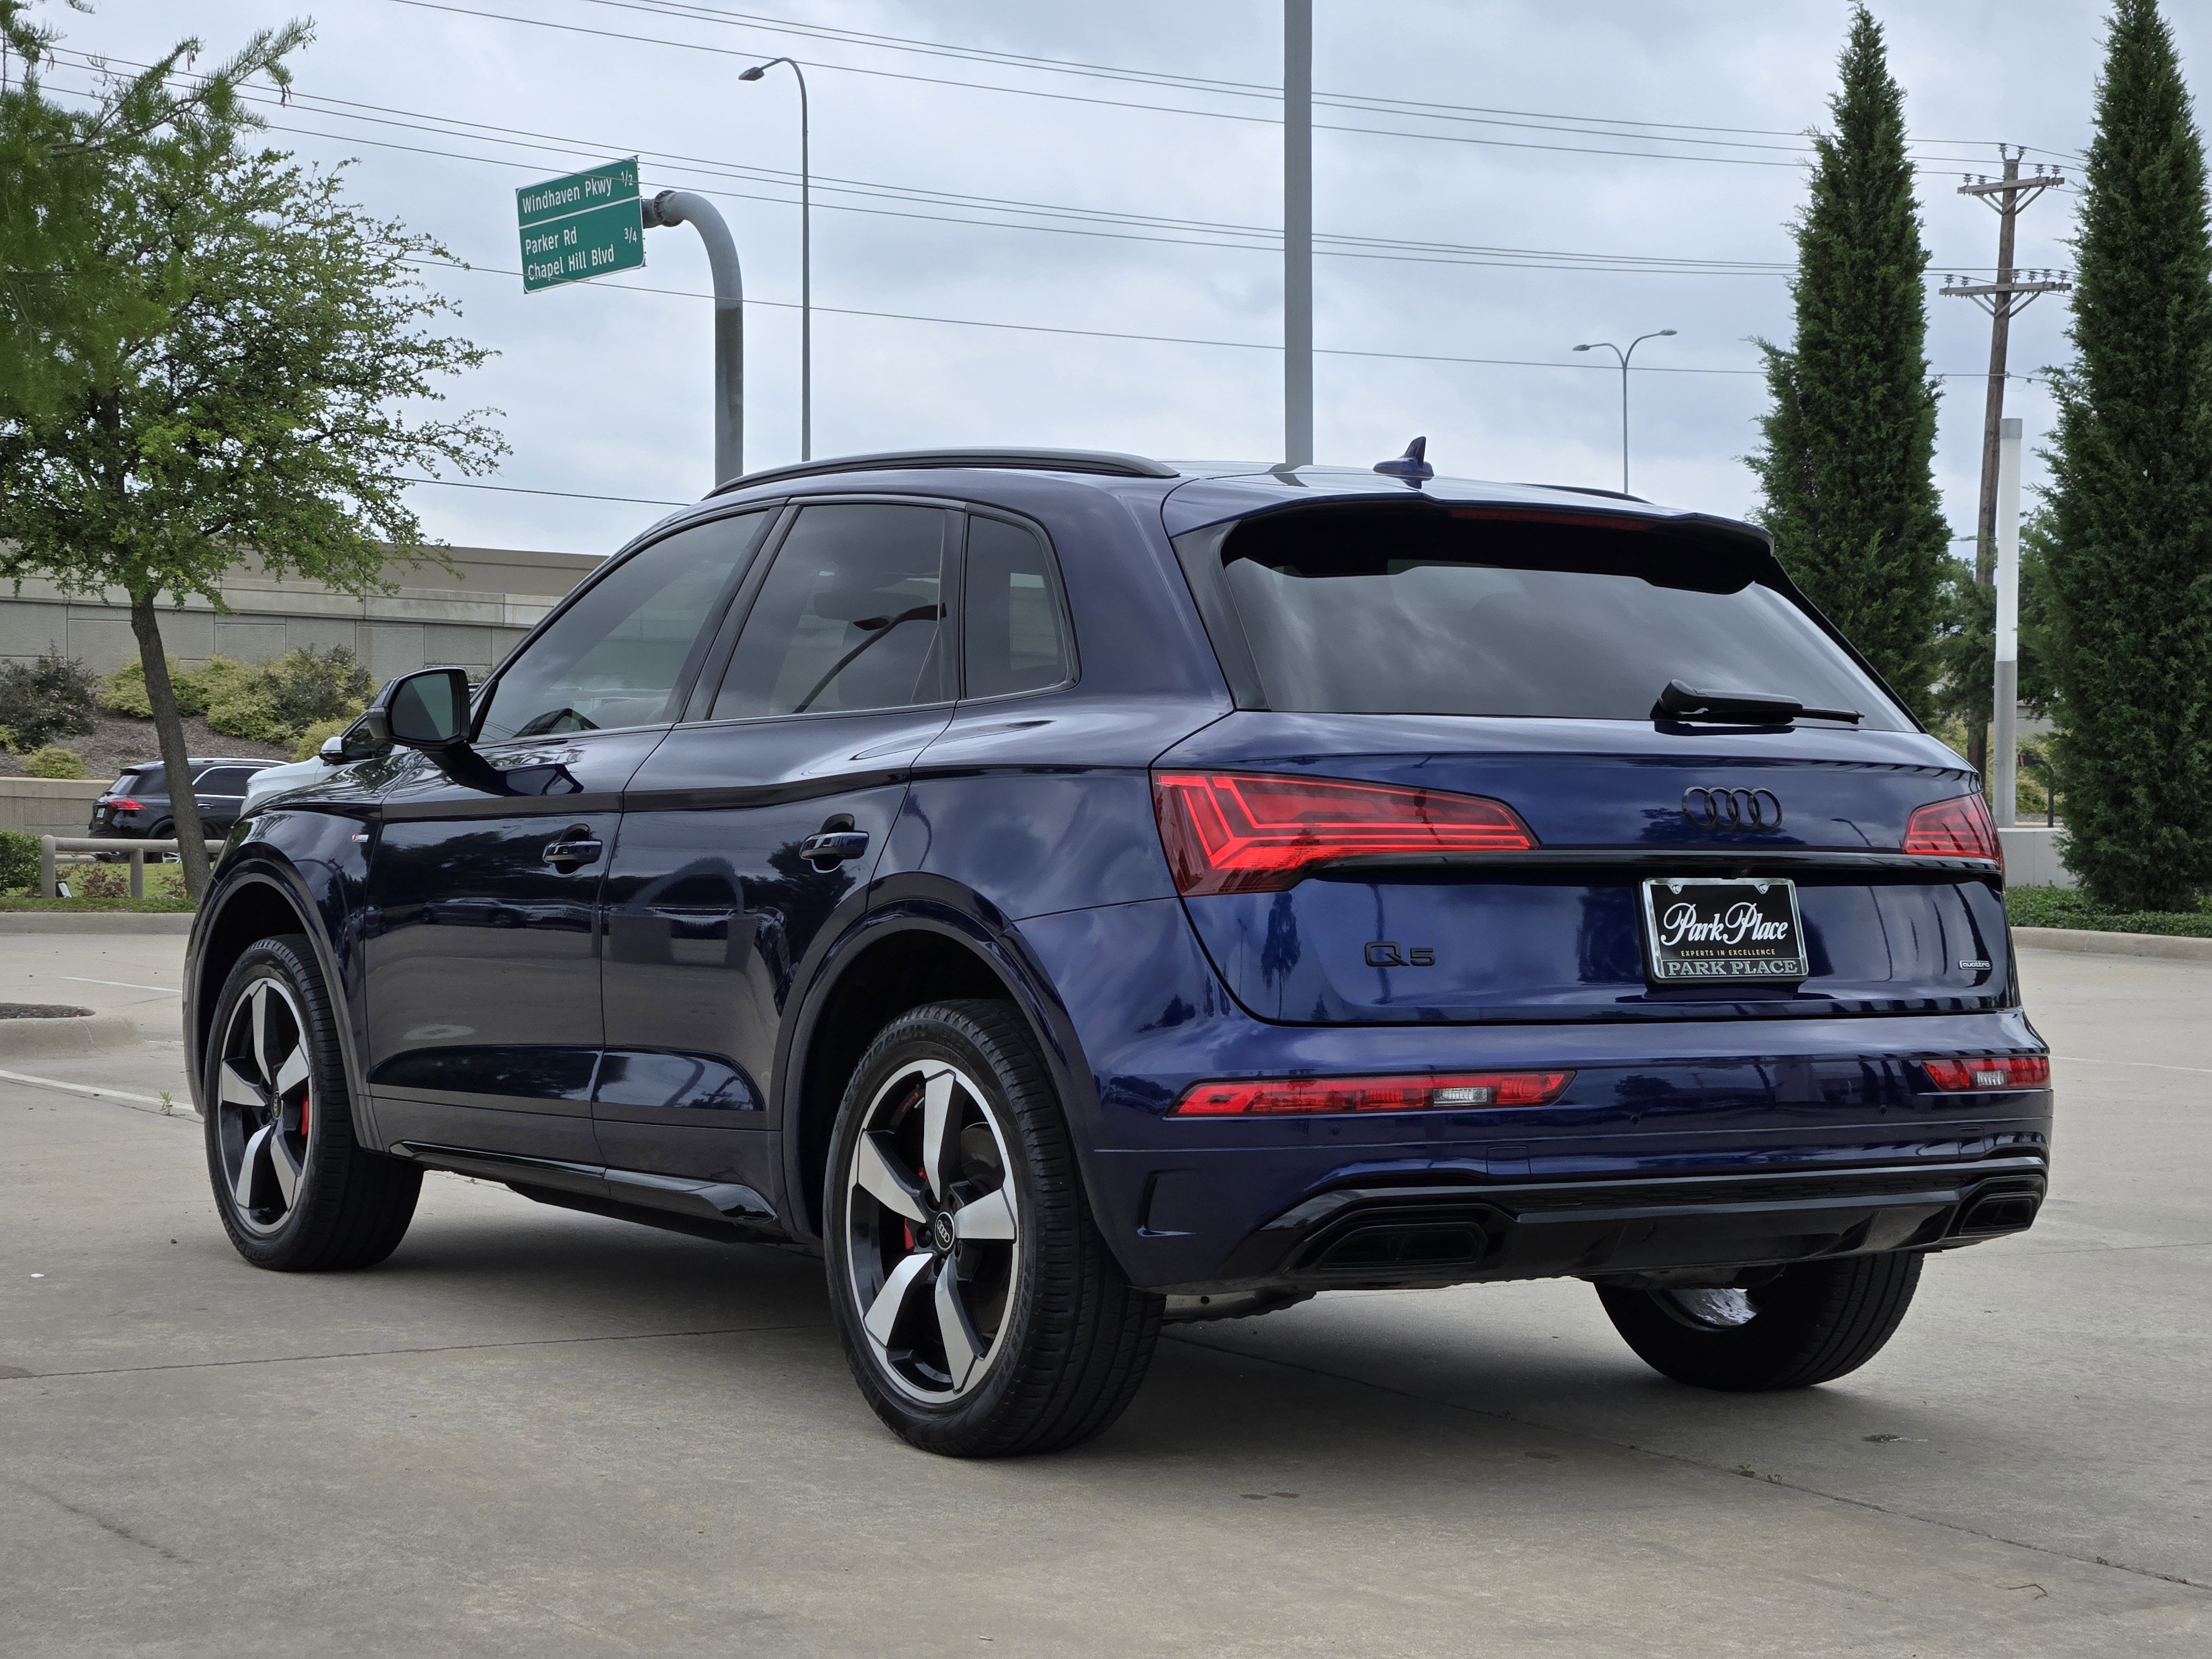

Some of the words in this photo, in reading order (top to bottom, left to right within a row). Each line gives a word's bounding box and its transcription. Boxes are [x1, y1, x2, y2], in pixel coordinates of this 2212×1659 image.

[522, 186, 580, 214] Windhaven
[585, 178, 612, 197] Pkwy
[620, 170, 633, 187] 1/2
[525, 233, 559, 255] Parker
[564, 226, 577, 246] Rd
[624, 227, 637, 244] 3/4
[528, 256, 564, 281] Chapel
[568, 251, 587, 272] Hill
[591, 244, 614, 266] Blvd
[1660, 902, 1725, 946] Park
[1722, 901, 1788, 945] Place
[1364, 941, 1436, 967] Q5
[1667, 961, 1726, 975] PARK
[1729, 960, 1798, 974] PLACE
